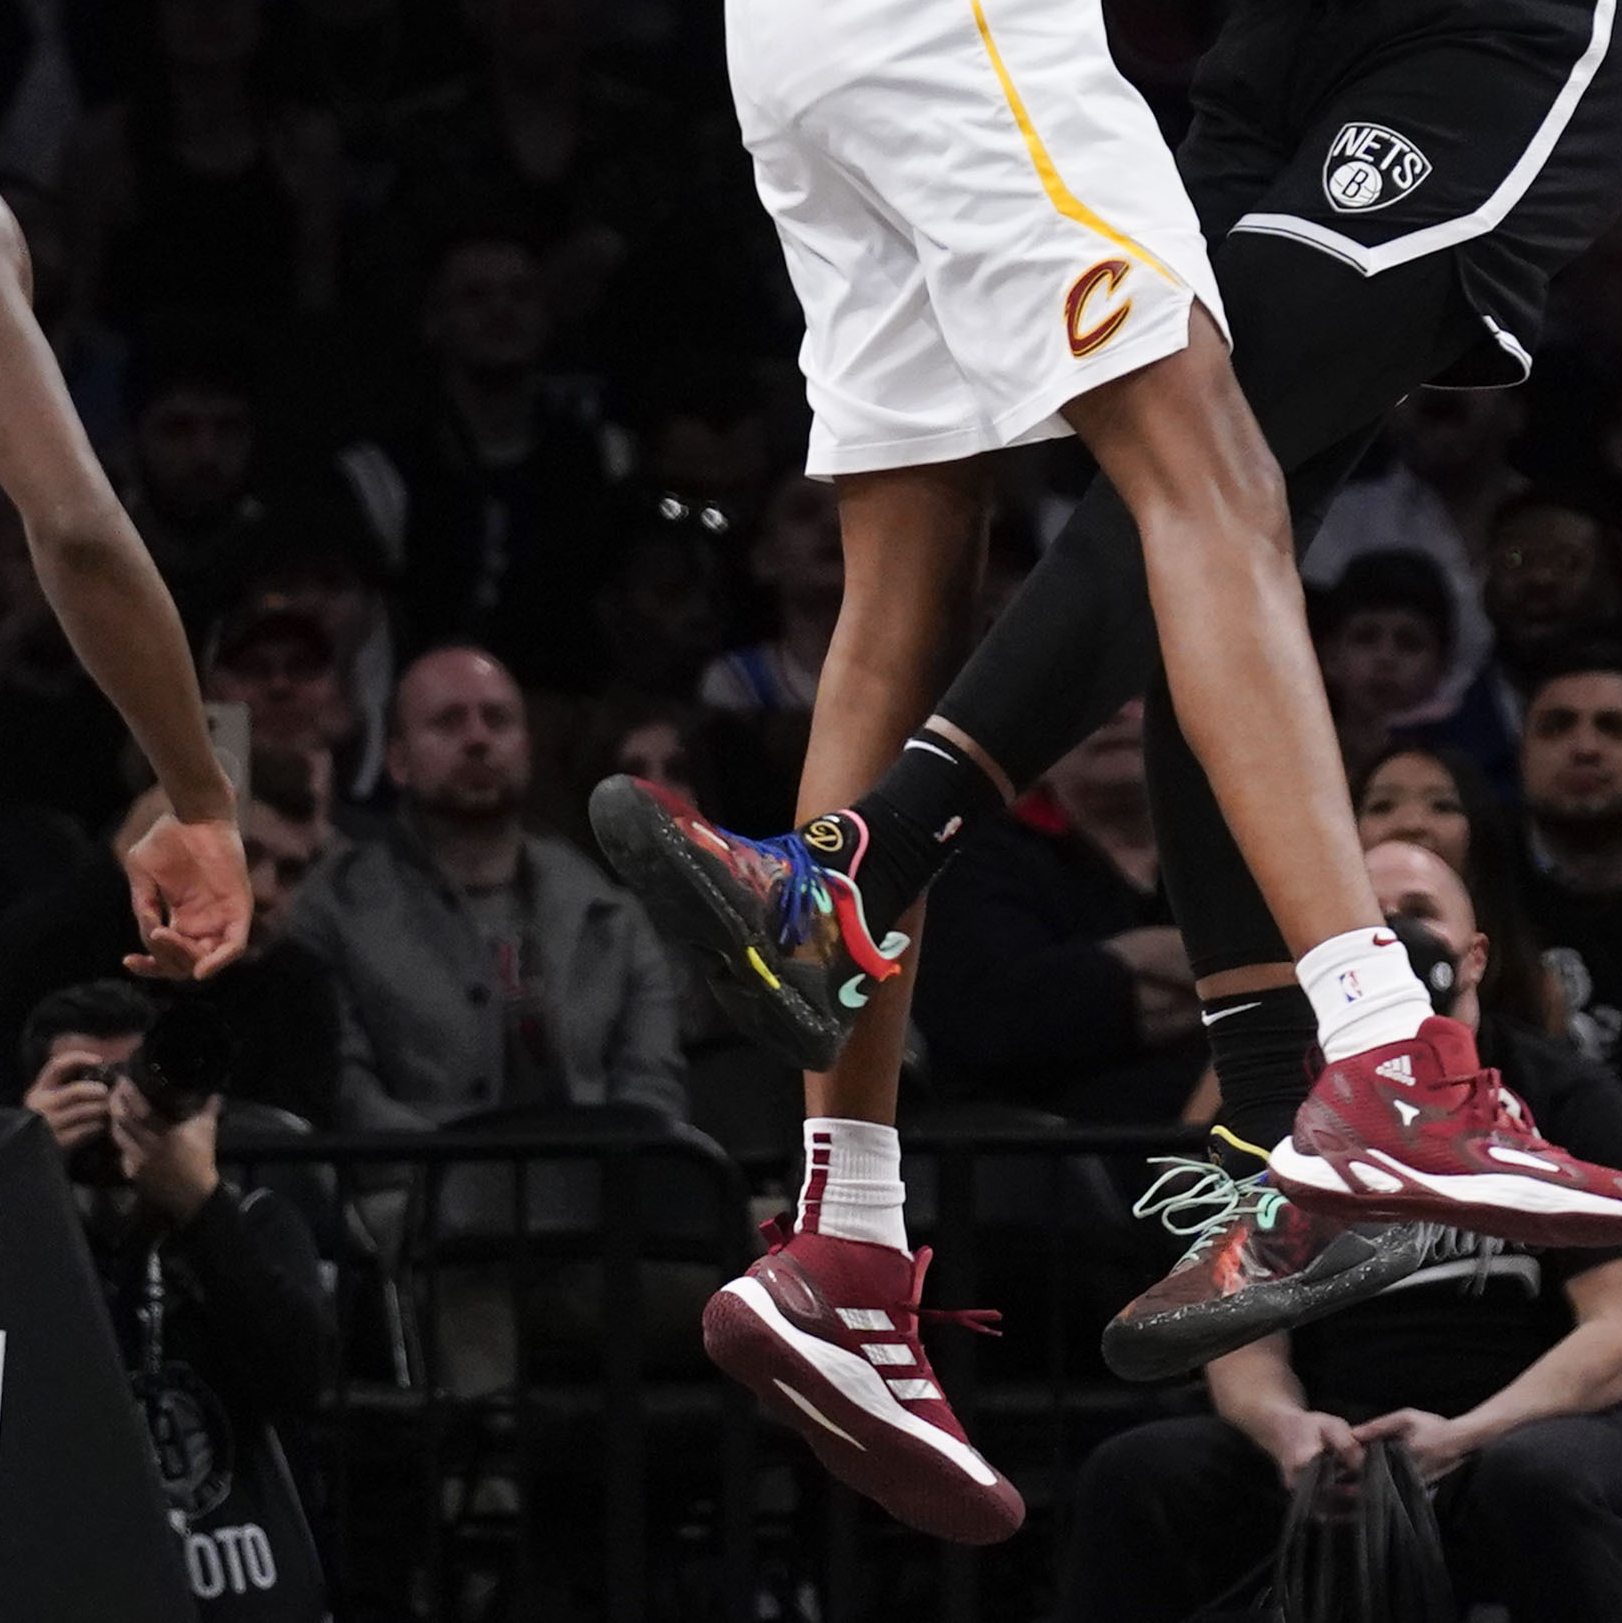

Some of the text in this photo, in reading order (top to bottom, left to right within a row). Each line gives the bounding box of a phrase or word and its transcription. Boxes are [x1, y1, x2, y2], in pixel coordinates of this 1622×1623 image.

[1332, 127, 1424, 190] NETS
[1341, 168, 1370, 199] B
[170, 1511, 277, 1599] OTO
